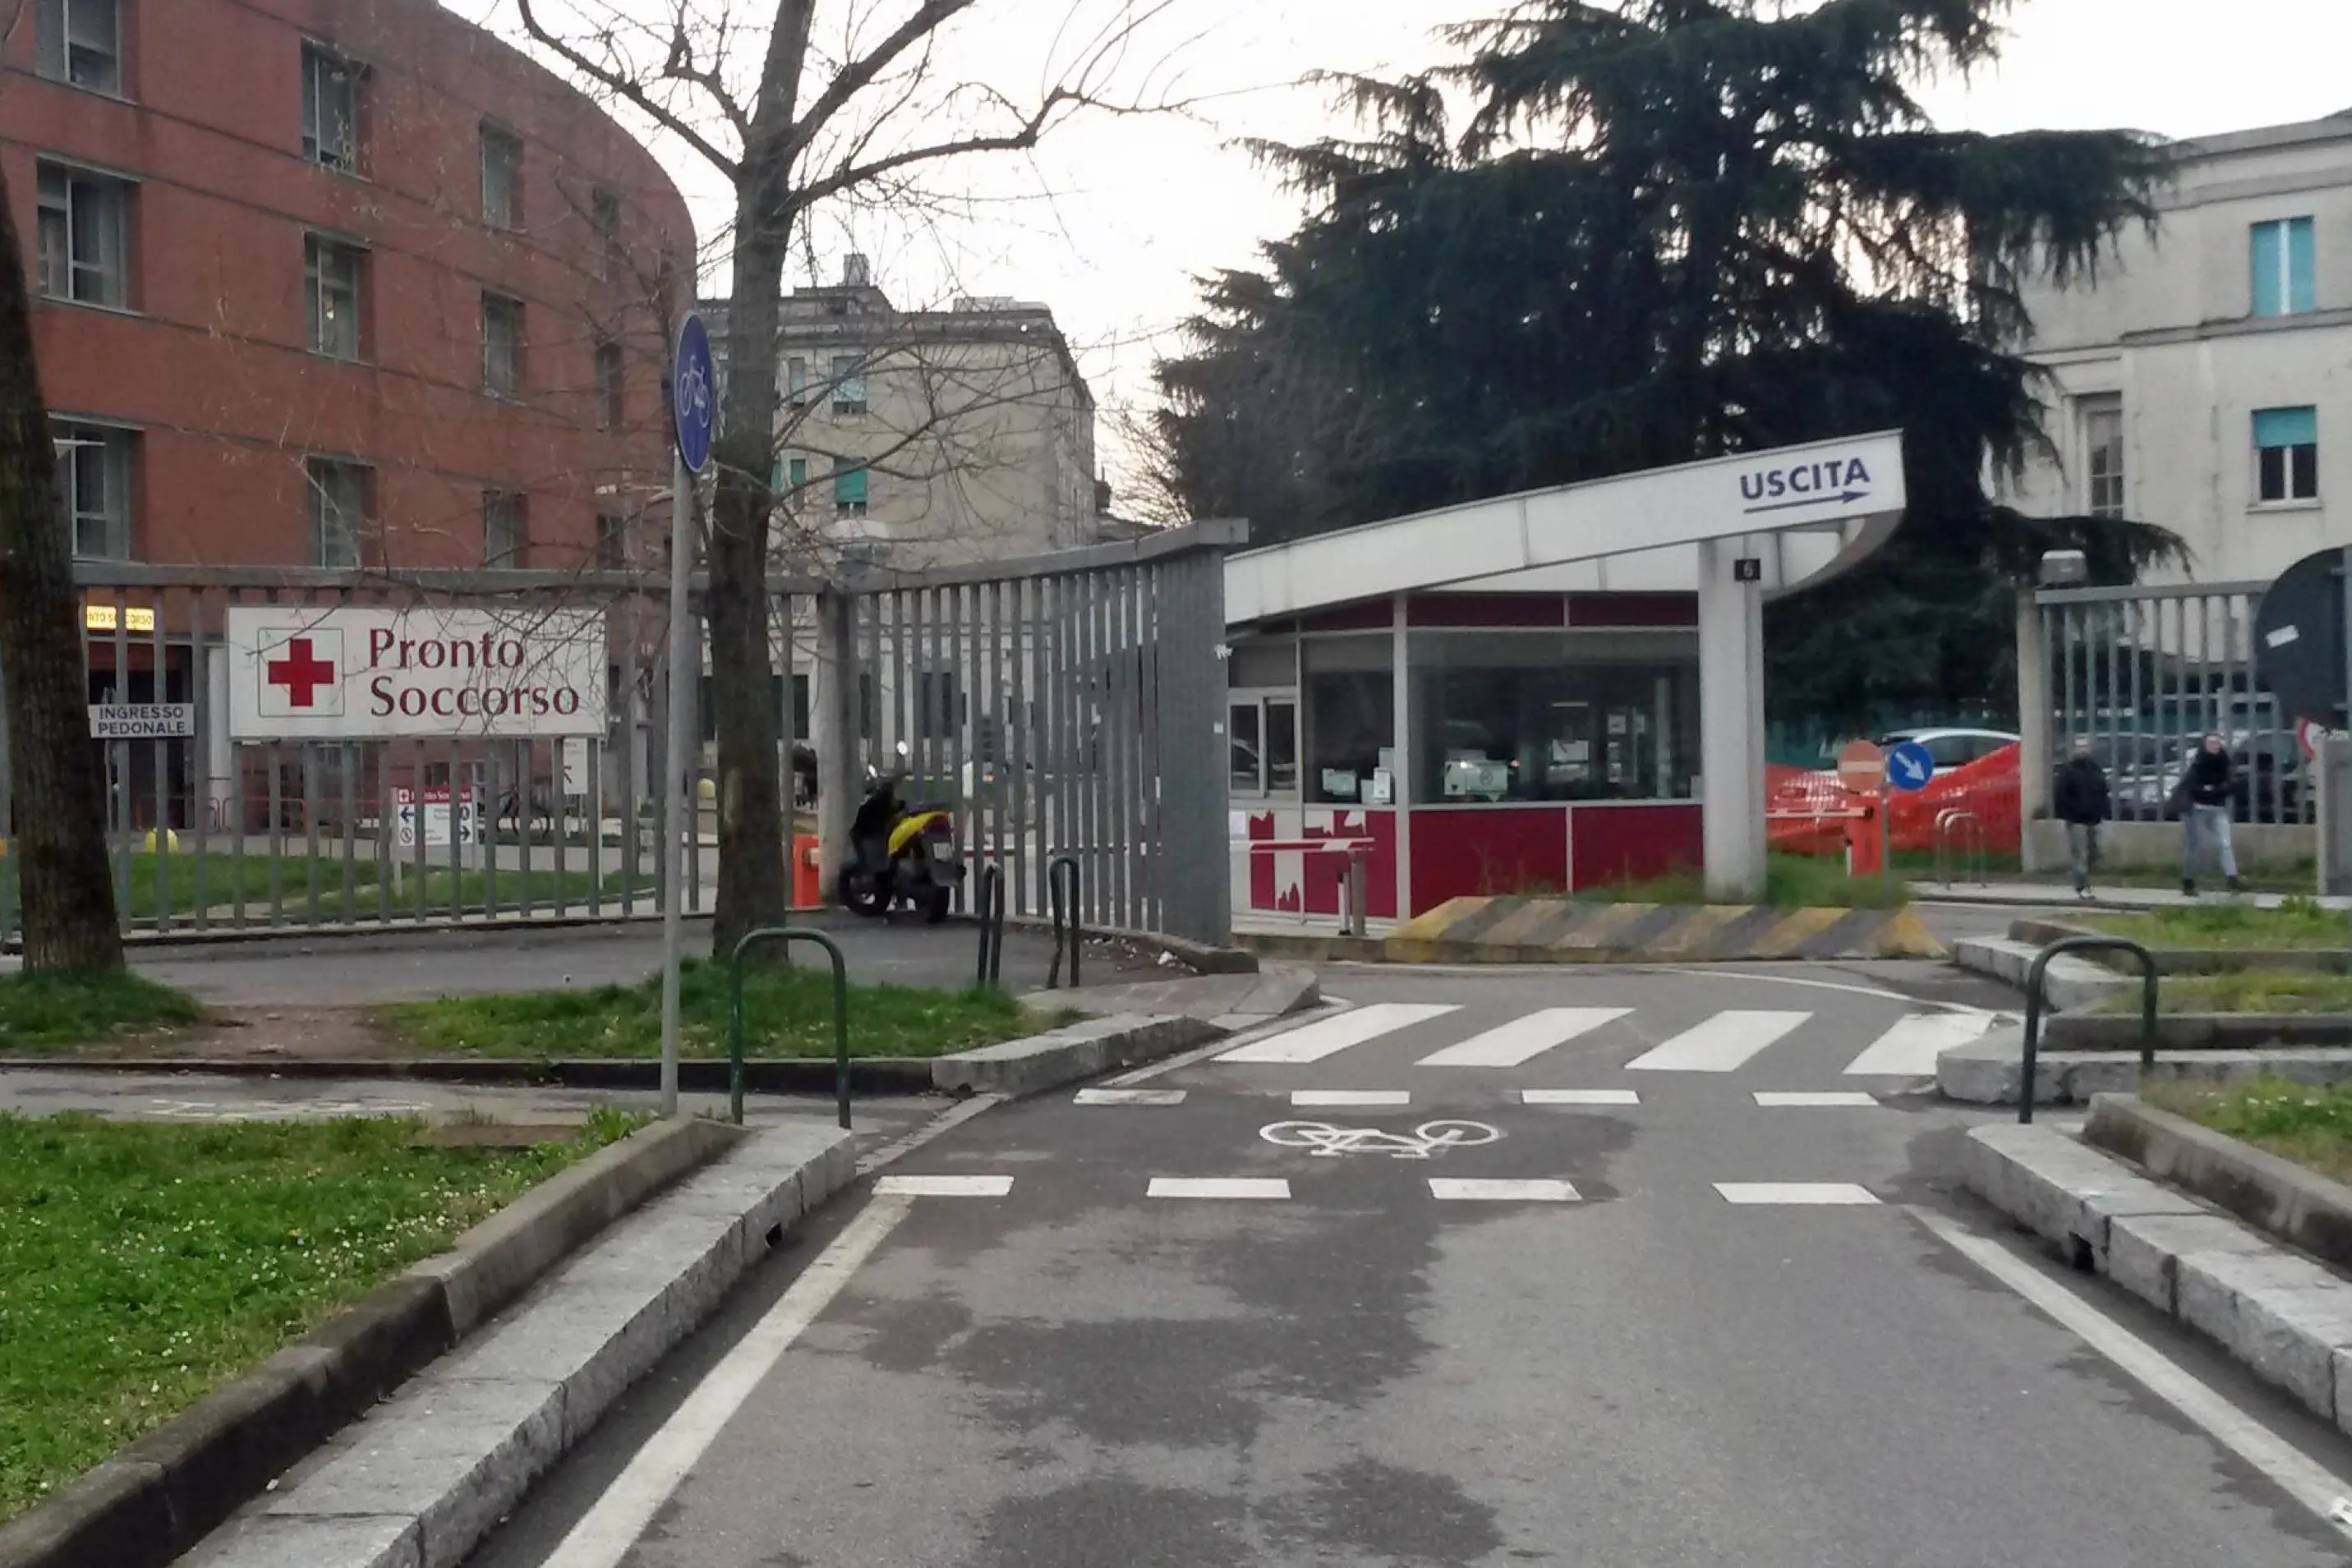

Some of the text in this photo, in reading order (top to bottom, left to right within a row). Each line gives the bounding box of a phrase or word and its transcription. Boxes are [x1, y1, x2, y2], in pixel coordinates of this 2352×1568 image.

[1740, 458, 1871, 499] USCITA
[370, 628, 524, 669] Pronto
[99, 706, 184, 720] INGRESSO
[371, 675, 580, 717] Soccorso
[98, 721, 186, 735] PEDONALE
